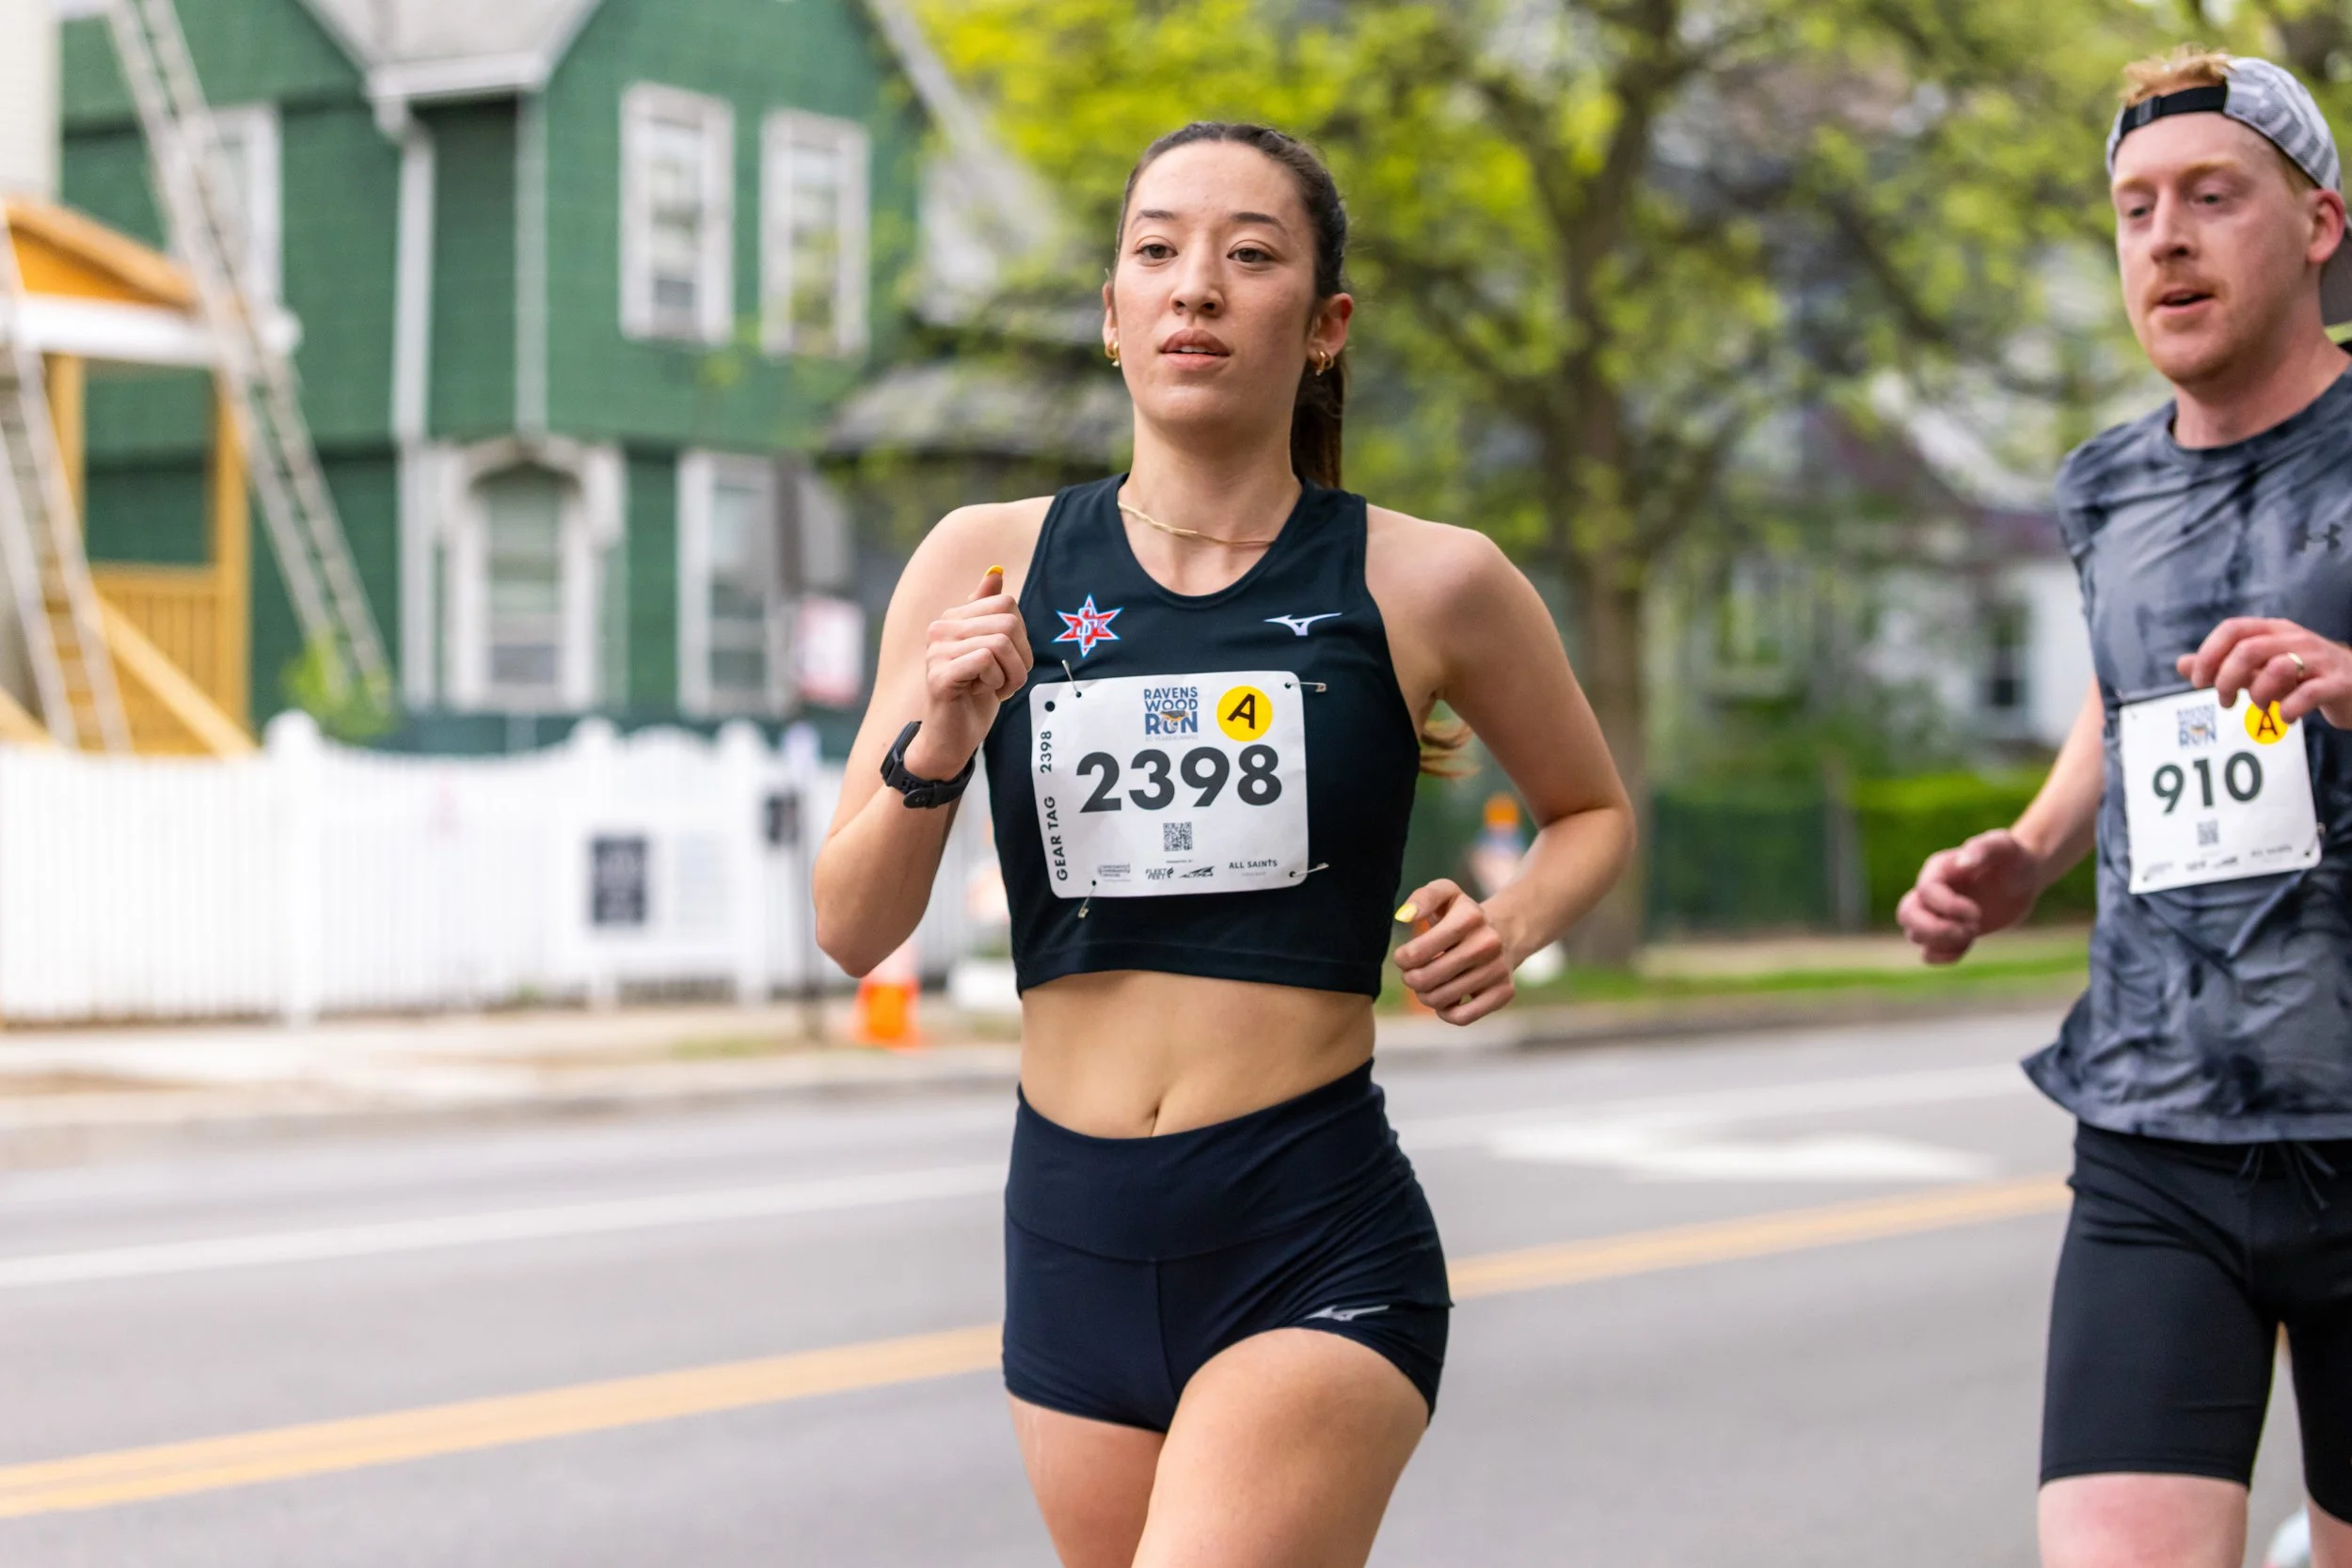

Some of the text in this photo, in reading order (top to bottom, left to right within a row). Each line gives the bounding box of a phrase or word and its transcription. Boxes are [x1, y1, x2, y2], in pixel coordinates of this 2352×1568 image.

[1144, 687, 1199, 700] RAVENS
[1145, 699, 1199, 712] WOOD
[1145, 711, 1199, 736] RUN
[1227, 693, 1256, 730] A
[2256, 712, 2279, 737] A
[1076, 744, 1282, 814] 2398
[2152, 752, 2263, 815] 910
[1040, 730, 1069, 881] GEAR TAG 2398
[1229, 858, 1278, 869] ALL SAINTS
